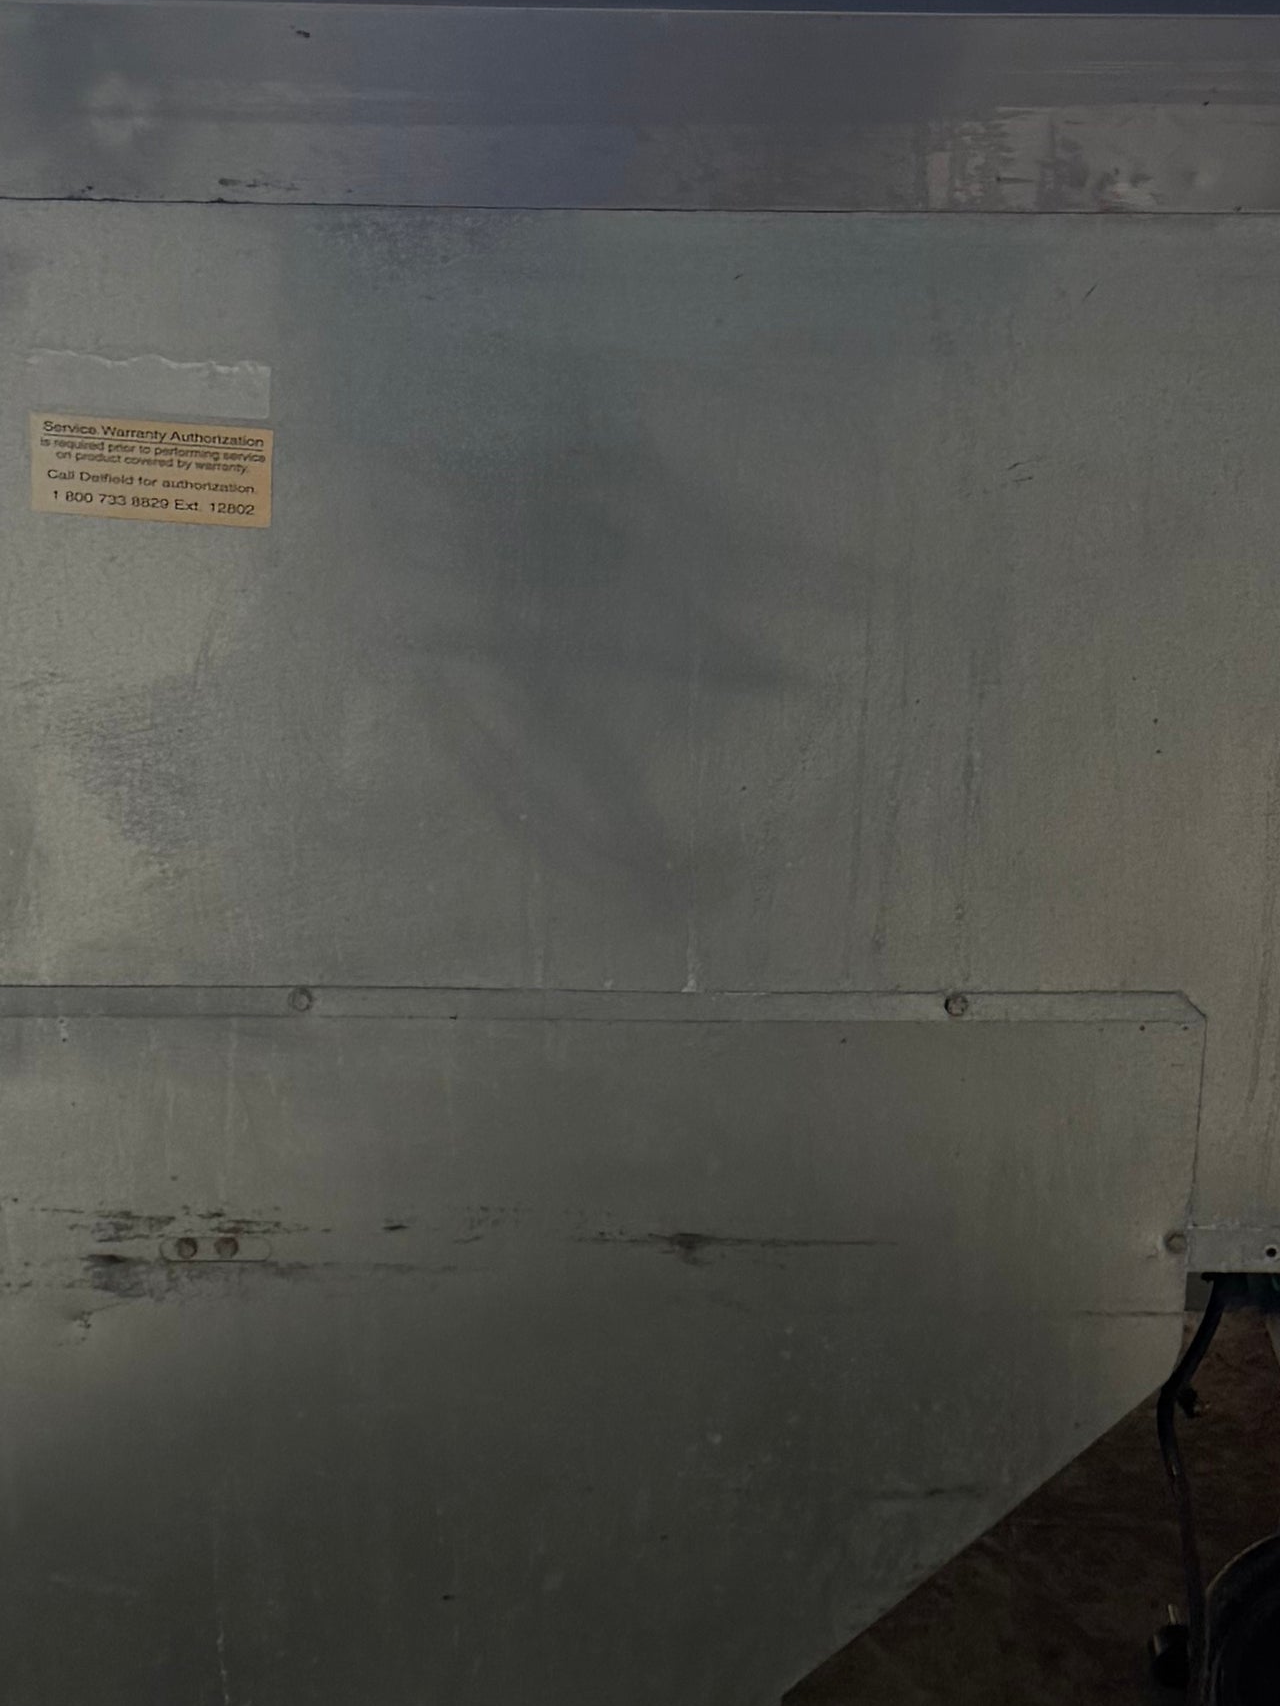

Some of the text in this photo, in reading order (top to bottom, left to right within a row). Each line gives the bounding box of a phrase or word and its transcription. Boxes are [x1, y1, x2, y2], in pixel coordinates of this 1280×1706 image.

[101, 425, 167, 443] Warranty
[170, 431, 264, 448] Authorization
[54, 439, 104, 451] required
[108, 443, 136, 453] prior
[139, 445, 151, 454] to
[154, 447, 220, 461] performing
[223, 452, 266, 463] service
[56, 451, 72, 459] on
[75, 452, 121, 463] product
[124, 455, 173, 467] covered
[177, 459, 192, 471] by
[47, 469, 75, 480] Call
[138, 476, 158, 487] for
[66, 491, 93, 503] 800
[99, 494, 126, 506] 733
[131, 496, 169, 509] 8829
[209, 502, 255, 516] 12802
